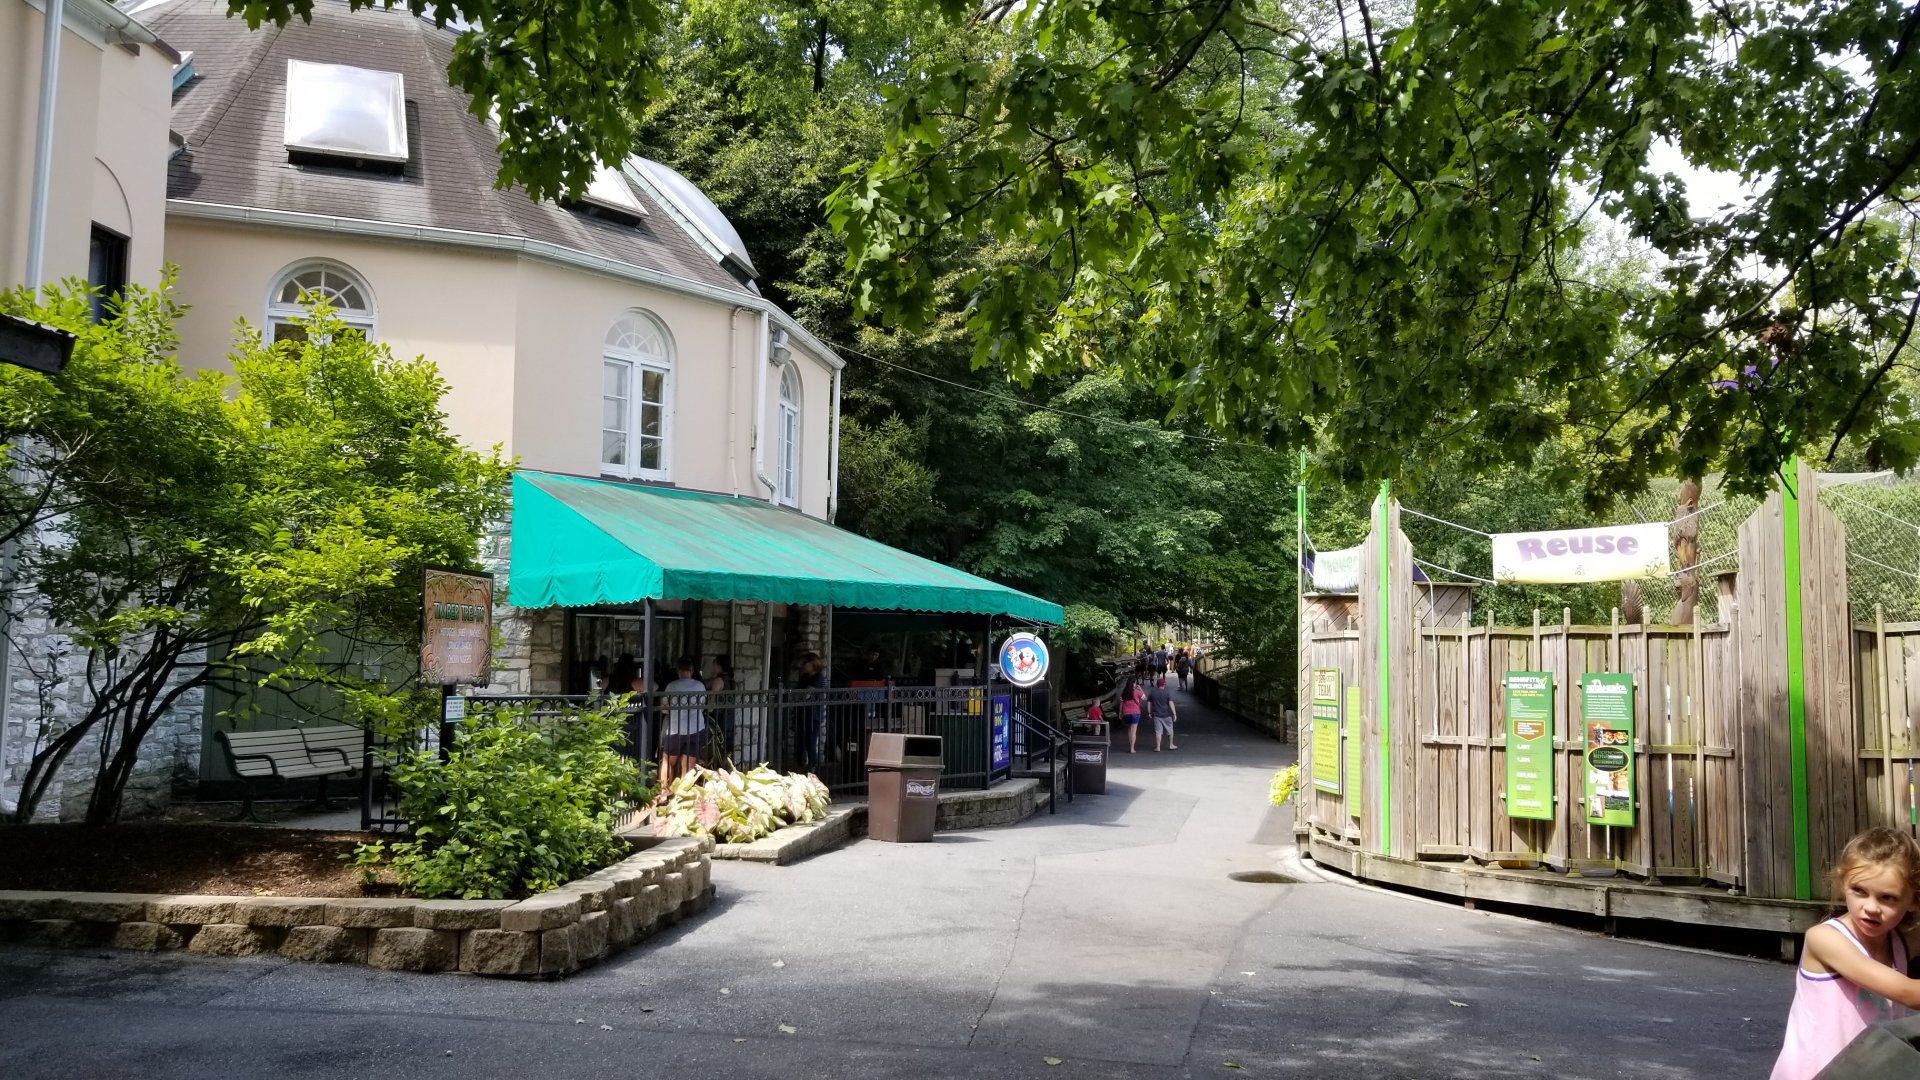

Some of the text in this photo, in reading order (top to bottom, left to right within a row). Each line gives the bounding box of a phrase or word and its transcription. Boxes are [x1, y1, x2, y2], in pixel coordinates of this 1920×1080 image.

[1516, 535, 1639, 562] Reuse
[433, 602, 485, 622] TIMBER TREATS
